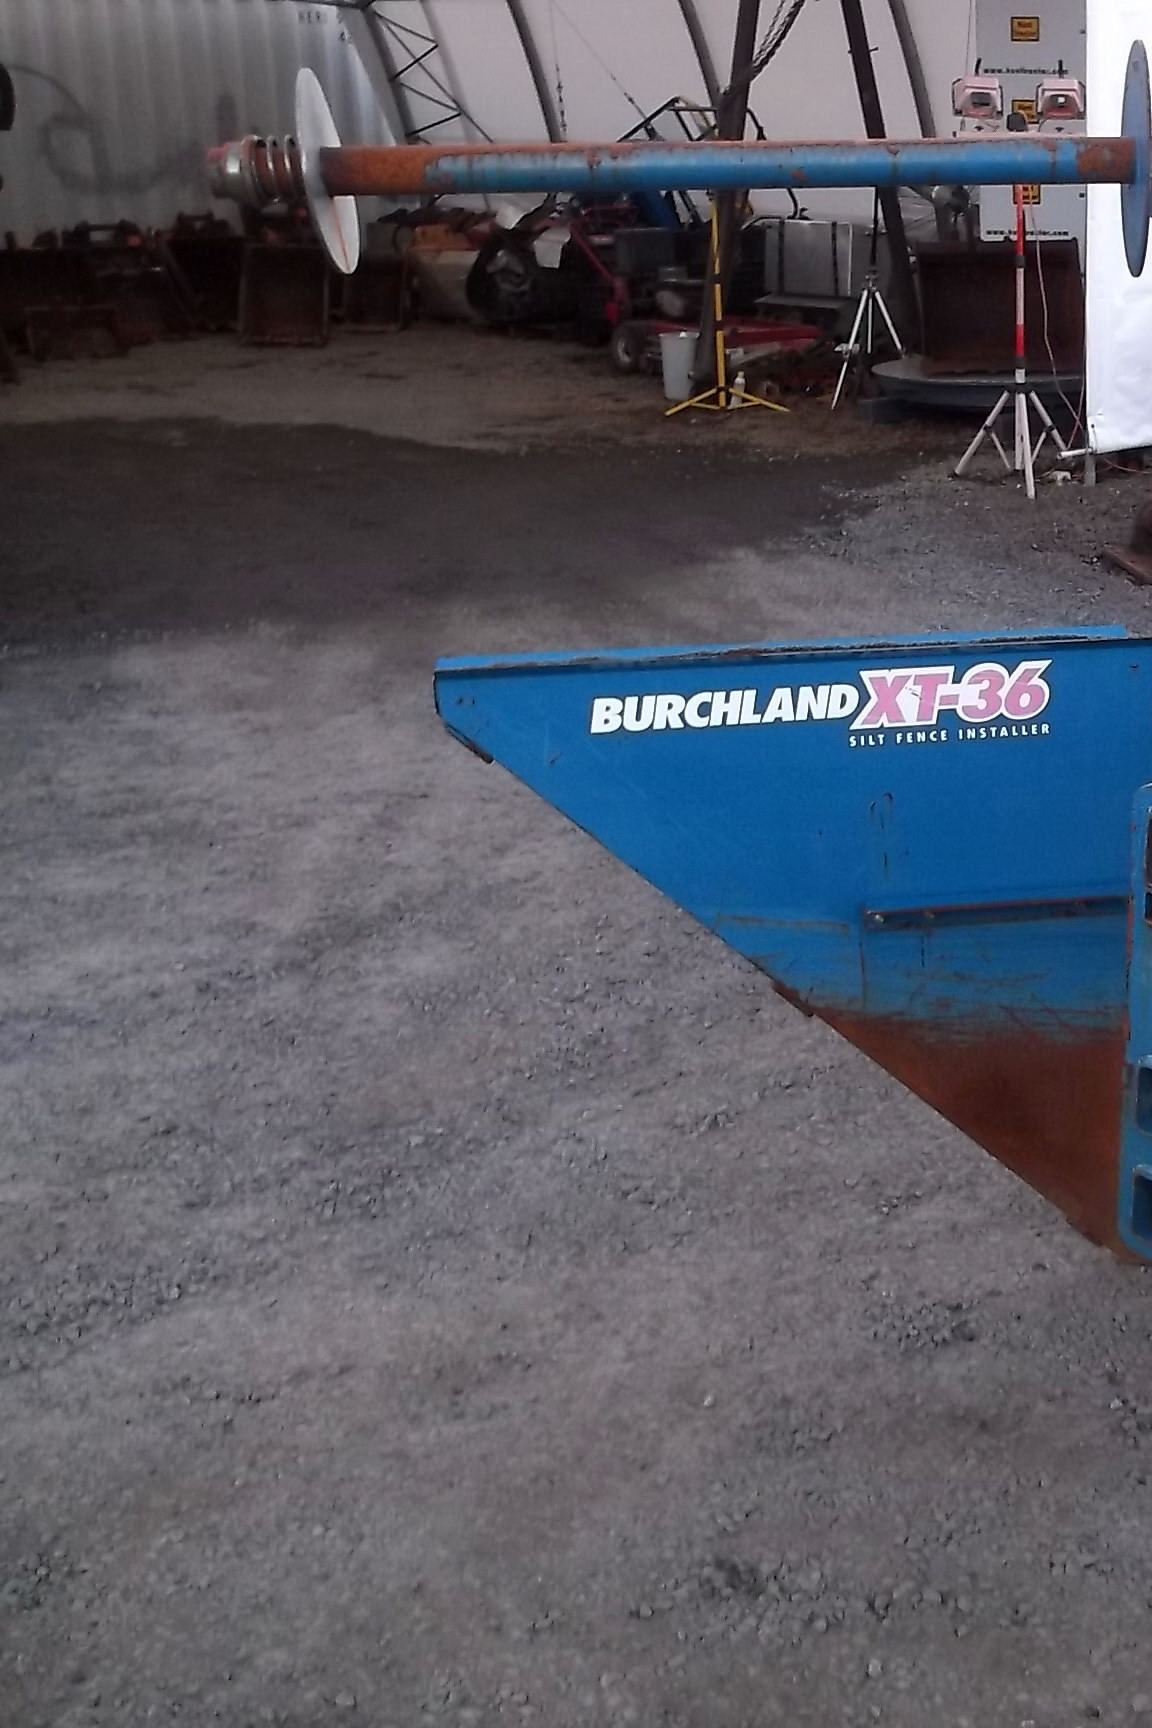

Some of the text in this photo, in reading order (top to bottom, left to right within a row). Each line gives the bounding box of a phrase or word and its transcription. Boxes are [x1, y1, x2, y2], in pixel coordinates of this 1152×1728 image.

[590, 660, 1052, 734] BURCHLAND XT-36
[849, 723, 1050, 747] SILT FENCE INSTALLER
